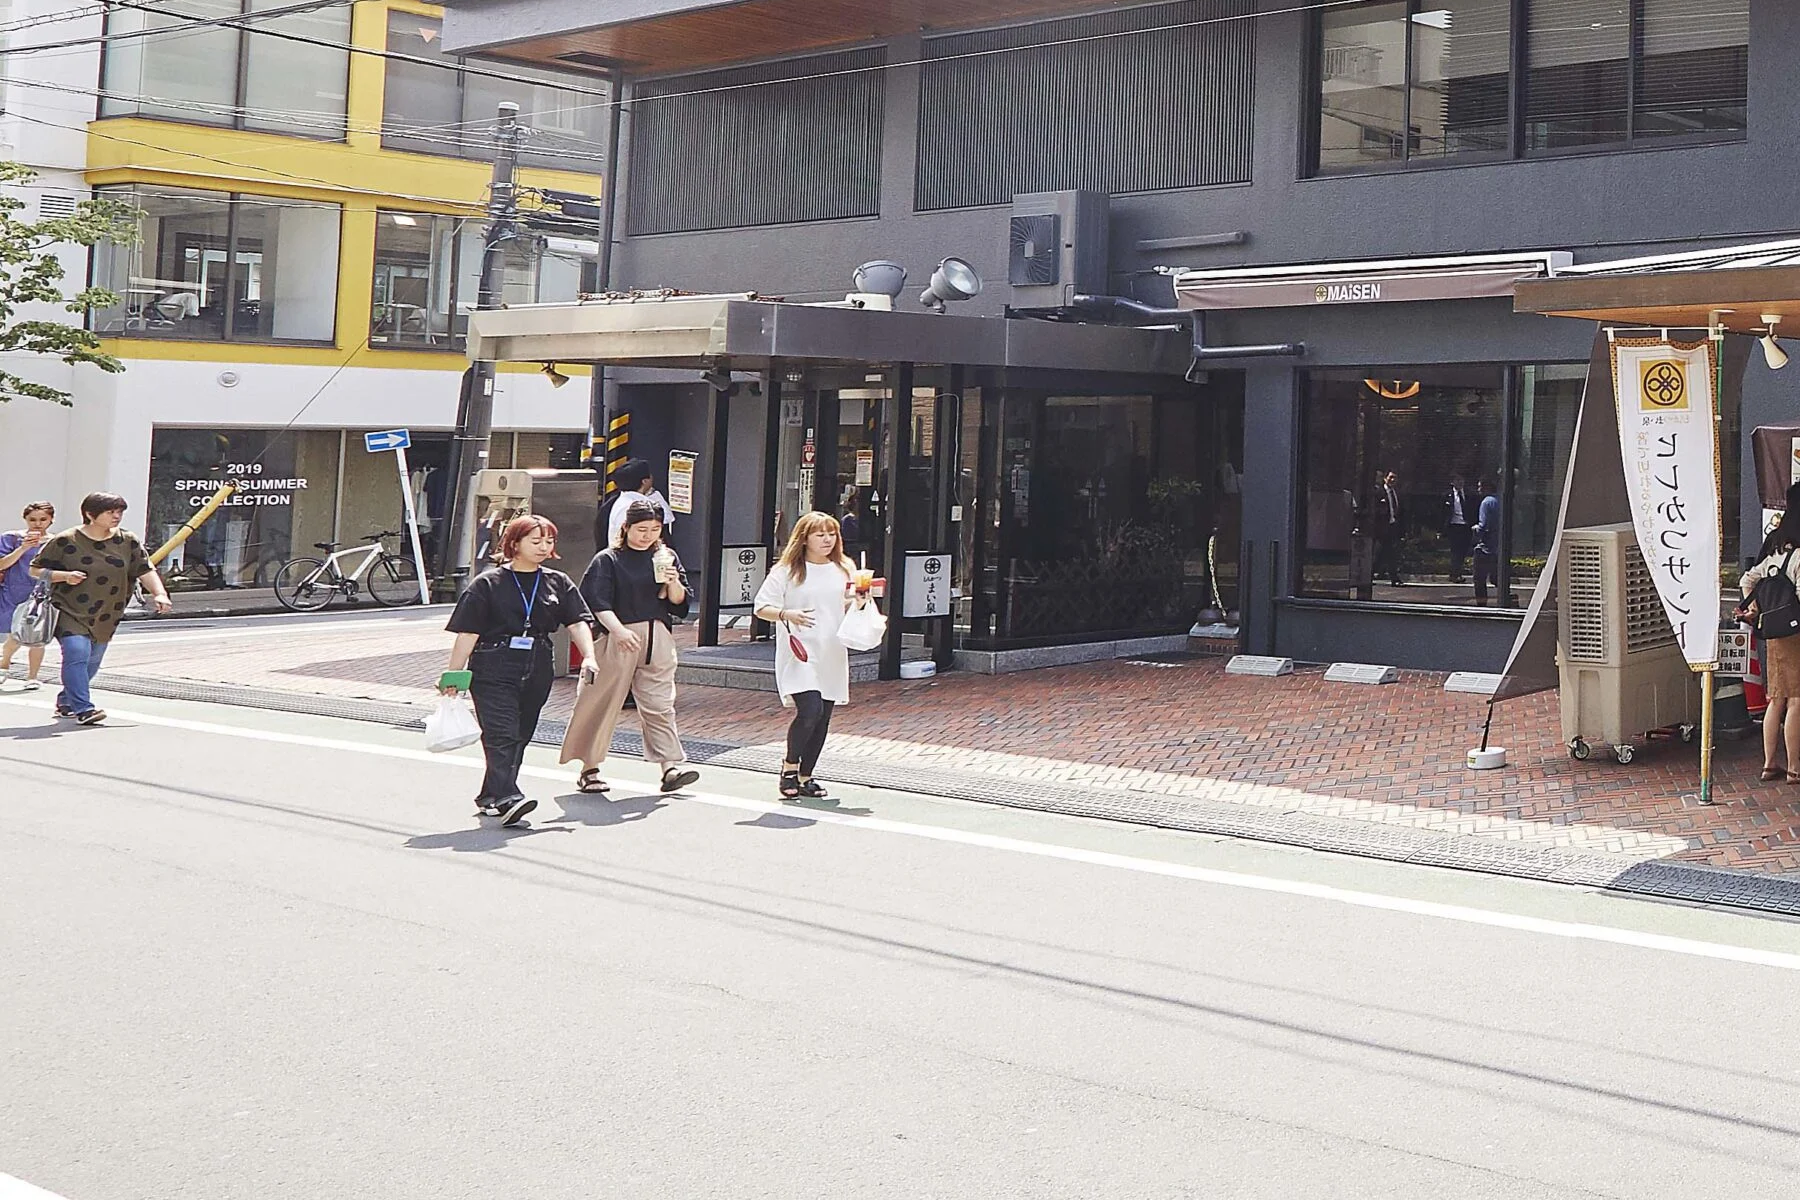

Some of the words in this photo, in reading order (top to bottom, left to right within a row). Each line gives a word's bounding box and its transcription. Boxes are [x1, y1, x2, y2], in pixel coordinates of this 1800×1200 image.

[227, 464, 262, 474] 2019
[175, 479, 236, 491] SPRIN
[189, 494, 290, 507] COLECTION
